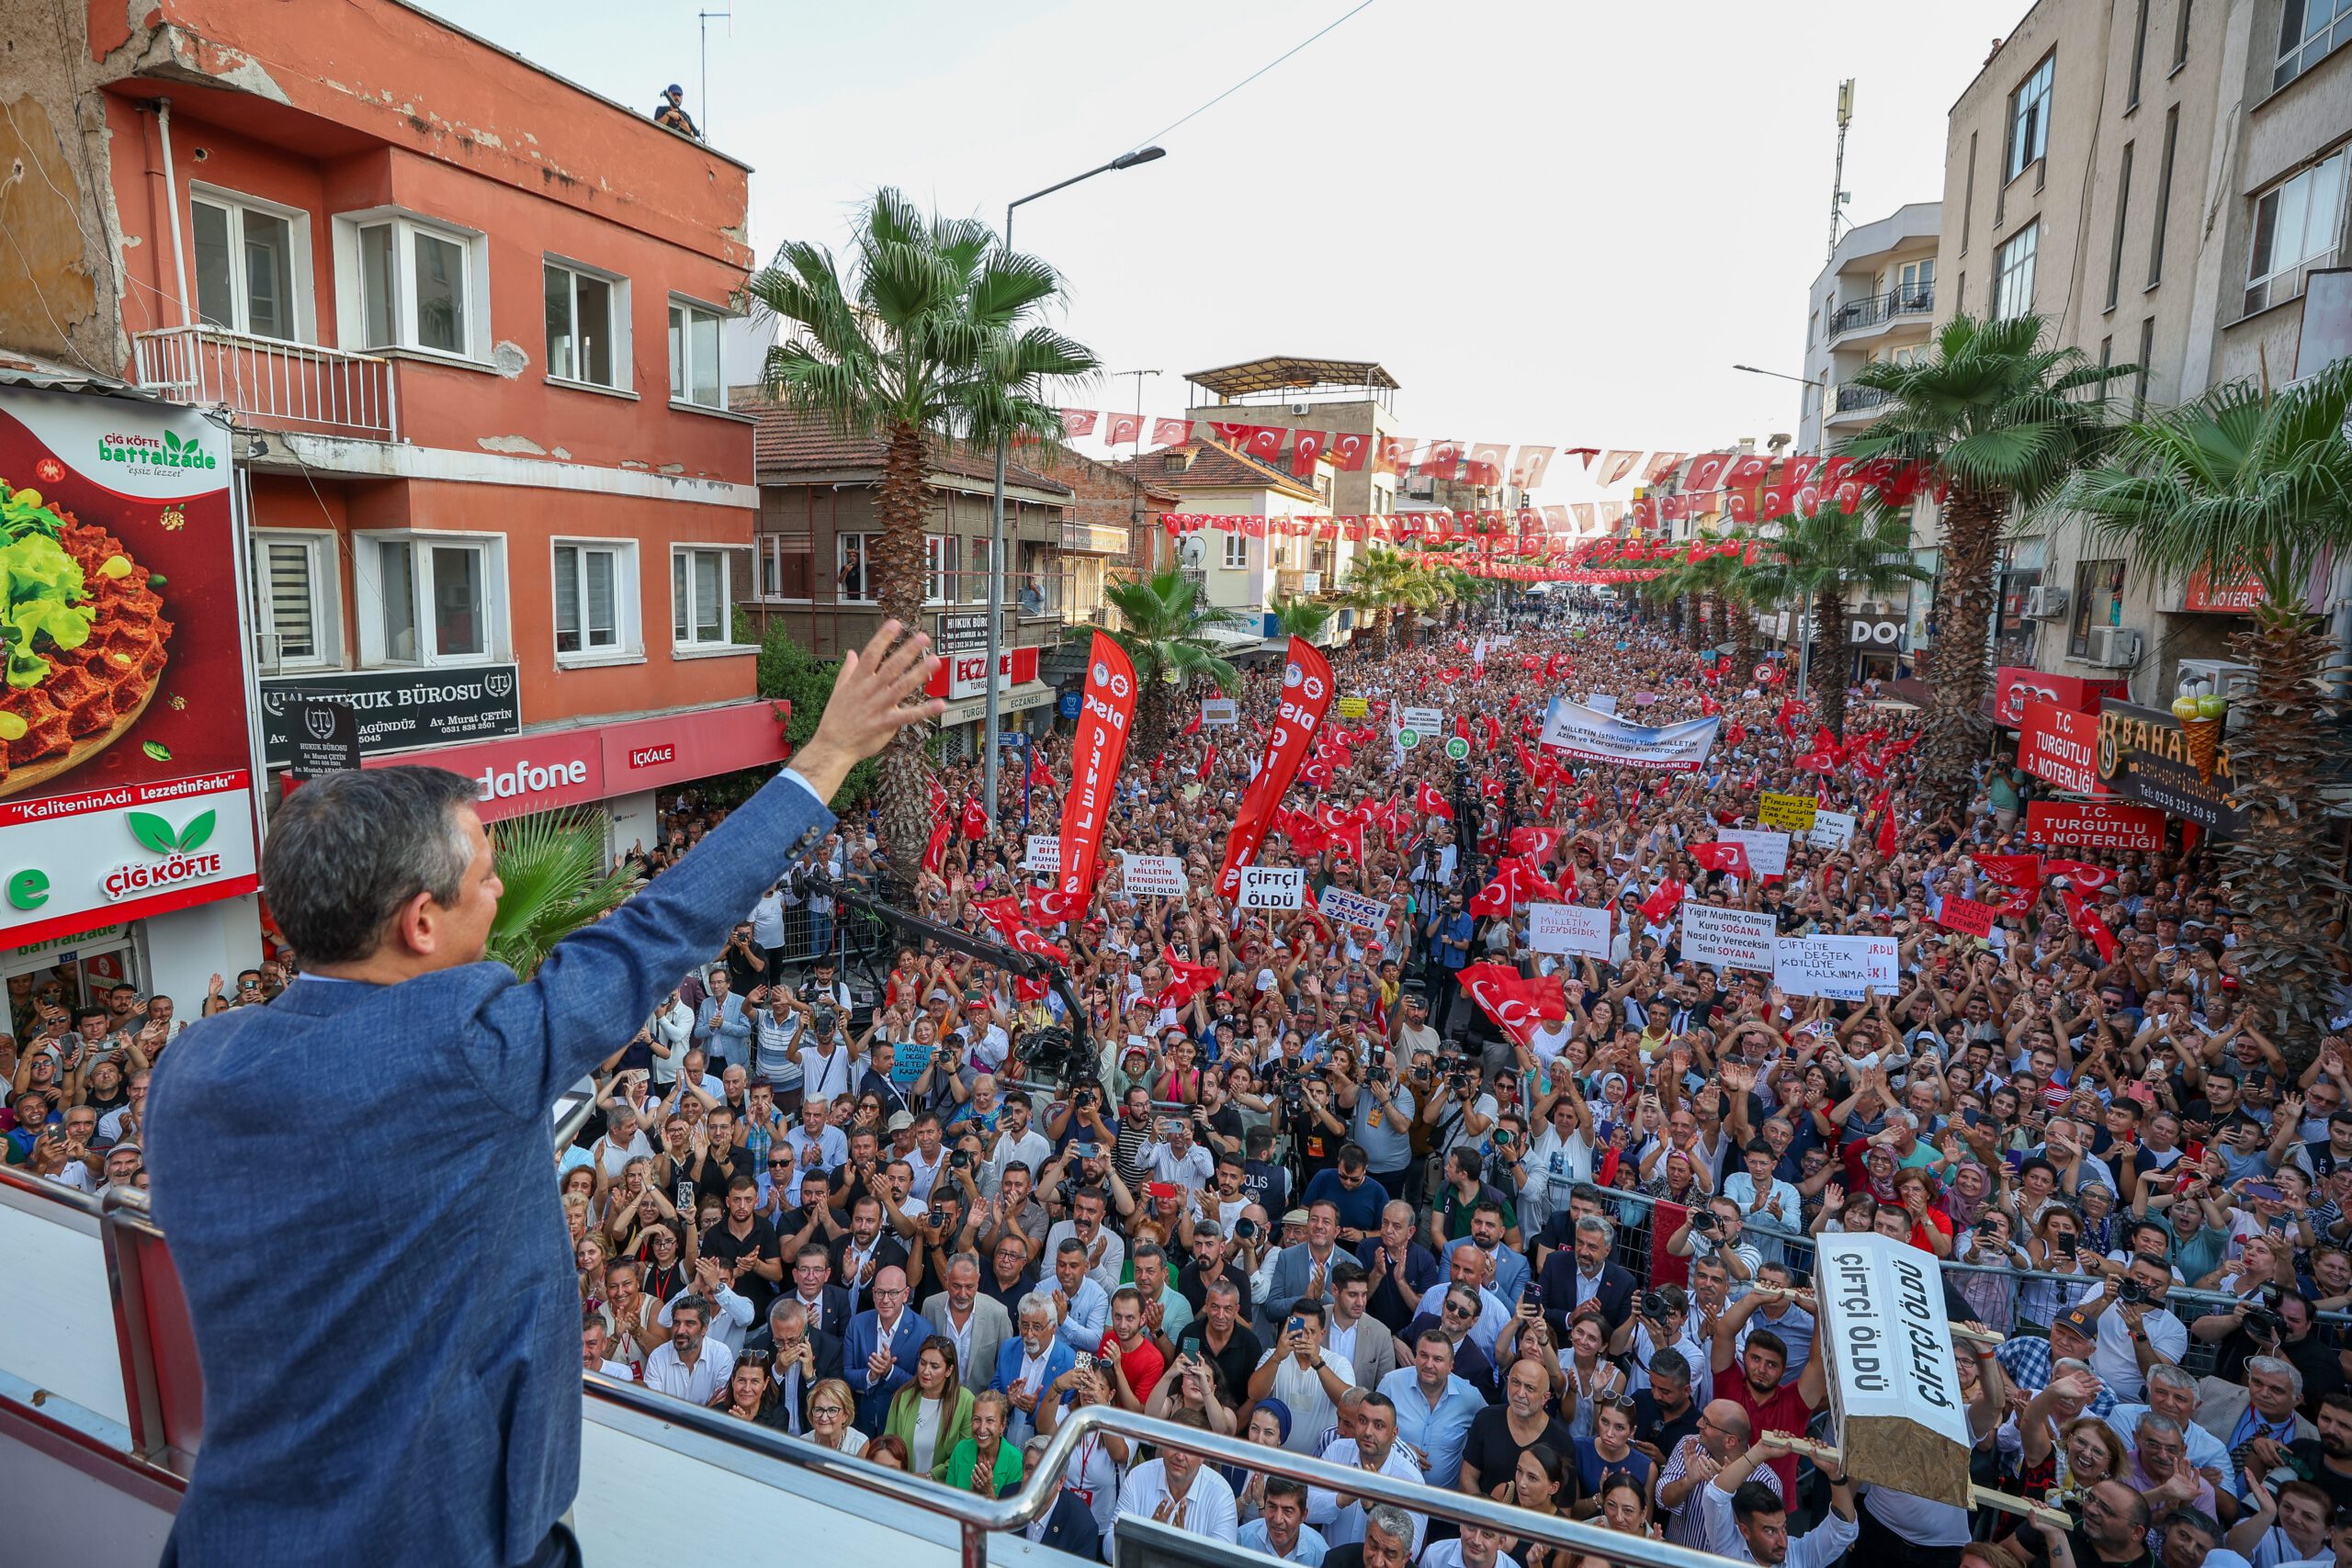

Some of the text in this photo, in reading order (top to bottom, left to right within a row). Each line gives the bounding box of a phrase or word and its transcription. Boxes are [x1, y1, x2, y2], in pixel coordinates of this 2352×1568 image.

[105, 433, 160, 448] ÇİĞ KÖFTE
[98, 439, 216, 469] battalzade
[397, 683, 482, 705] BÜROSU
[429, 708, 512, 727] Av. Murat ÇETİN
[2055, 711, 2073, 734] T.C.
[269, 734, 288, 744] Av.
[1556, 731, 1577, 741] Azim
[1560, 724, 1597, 737] MİLLETİN
[300, 742, 347, 751] HUKUK BÜROSU
[2036, 730, 2091, 767] TURGUTLU
[633, 747, 672, 767] İÇKALE
[1556, 747, 1691, 770] CHP KARABAĞLAR İLÇE BAŞKANLIĞI
[476, 760, 587, 802] dafone
[2028, 753, 2095, 794] 3. NOTERLİĞİ
[2079, 807, 2112, 818] T.C.
[2140, 784, 2217, 824] Tel: 0236 235 20 95
[2044, 818, 2146, 834] TURGUTLU
[2031, 830, 2156, 850] 3. NOTERLİĞİ
[1133, 867, 1172, 875] MİLLETİN
[1139, 858, 1165, 867] ÇİFTÇİ
[106, 854, 220, 897] ÇİĞ KÖFTE
[1128, 876, 1179, 886] EFENDİSİYDİ
[1247, 869, 1297, 888] ÇİFTÇİ
[1127, 885, 1181, 895] KÖLESİ OLDU
[1248, 891, 1294, 908] ÖLDÜ
[1326, 894, 1385, 918] SEVGİ
[1339, 891, 1376, 907] TOPRAĞA
[1326, 908, 1374, 928] SAYGI
[1335, 905, 1371, 919] EMEĞE
[1688, 907, 1771, 928] Yiğit Muhtaç Olmuş
[1699, 920, 1760, 937] Kuru SOĞANA
[1687, 931, 1770, 950] Nasıl Oy Vereceksin
[62, 953, 75, 963] 127
[1698, 943, 1756, 960] Seni SOYANA
[1804, 952, 1852, 961] DESTEK
[1782, 959, 1835, 968] KÖYLÜYE
[1806, 970, 1867, 981] KALKINMA
[1244, 1174, 1268, 1189] OLIS
[1832, 1253, 1889, 1392] ÇİFTÇİ ÖLDÜ
[1893, 1260, 1955, 1410] ÇİFTÇİ ÖLDÜ
